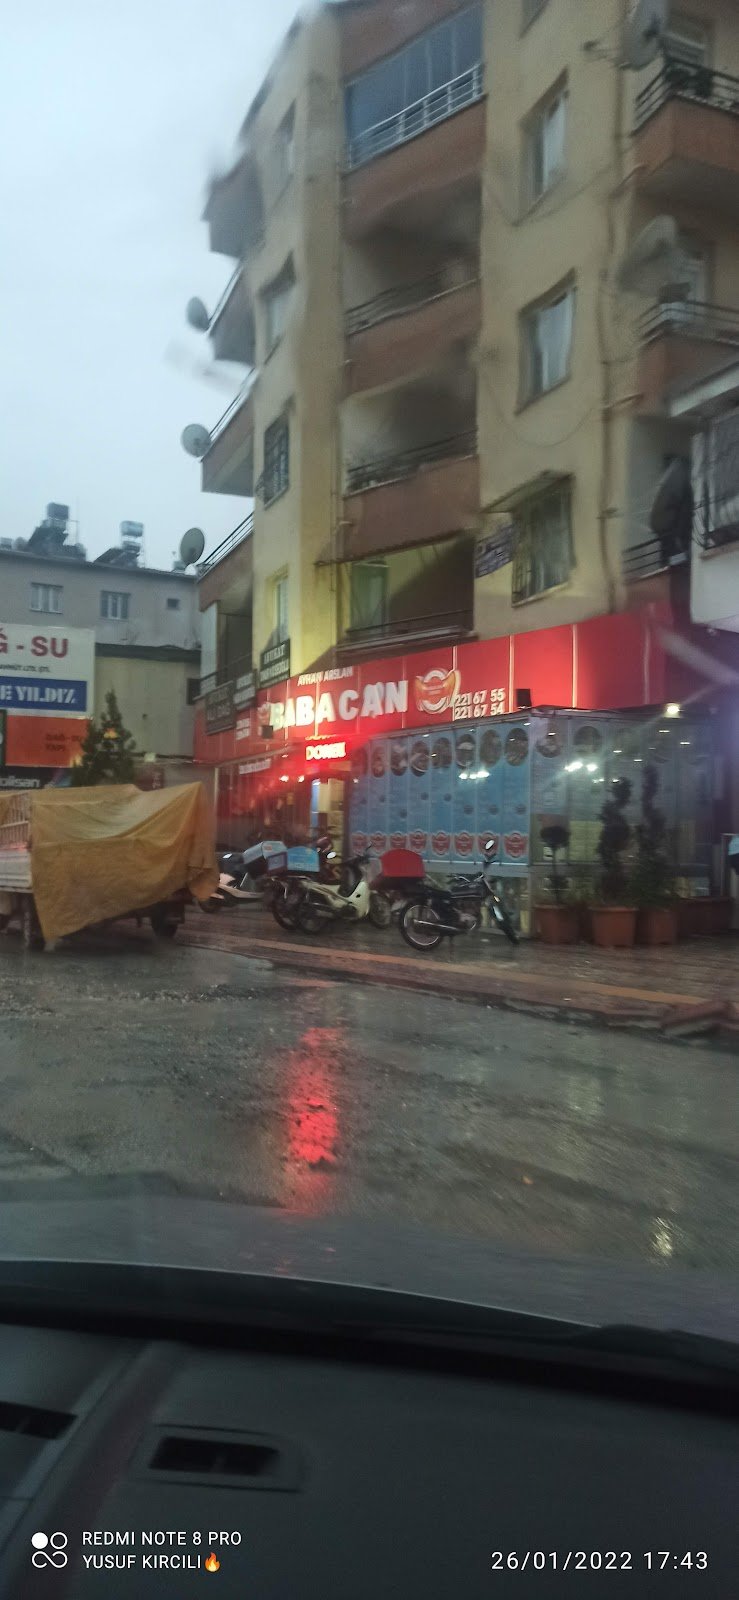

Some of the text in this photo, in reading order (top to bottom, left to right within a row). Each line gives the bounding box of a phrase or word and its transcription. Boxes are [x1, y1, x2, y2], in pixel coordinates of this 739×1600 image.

[31, 636, 69, 658] SU
[15, 686, 79, 704] YILDIZ
[454, 688, 506, 706] 221 67 55
[454, 702, 506, 720] 221 67 54
